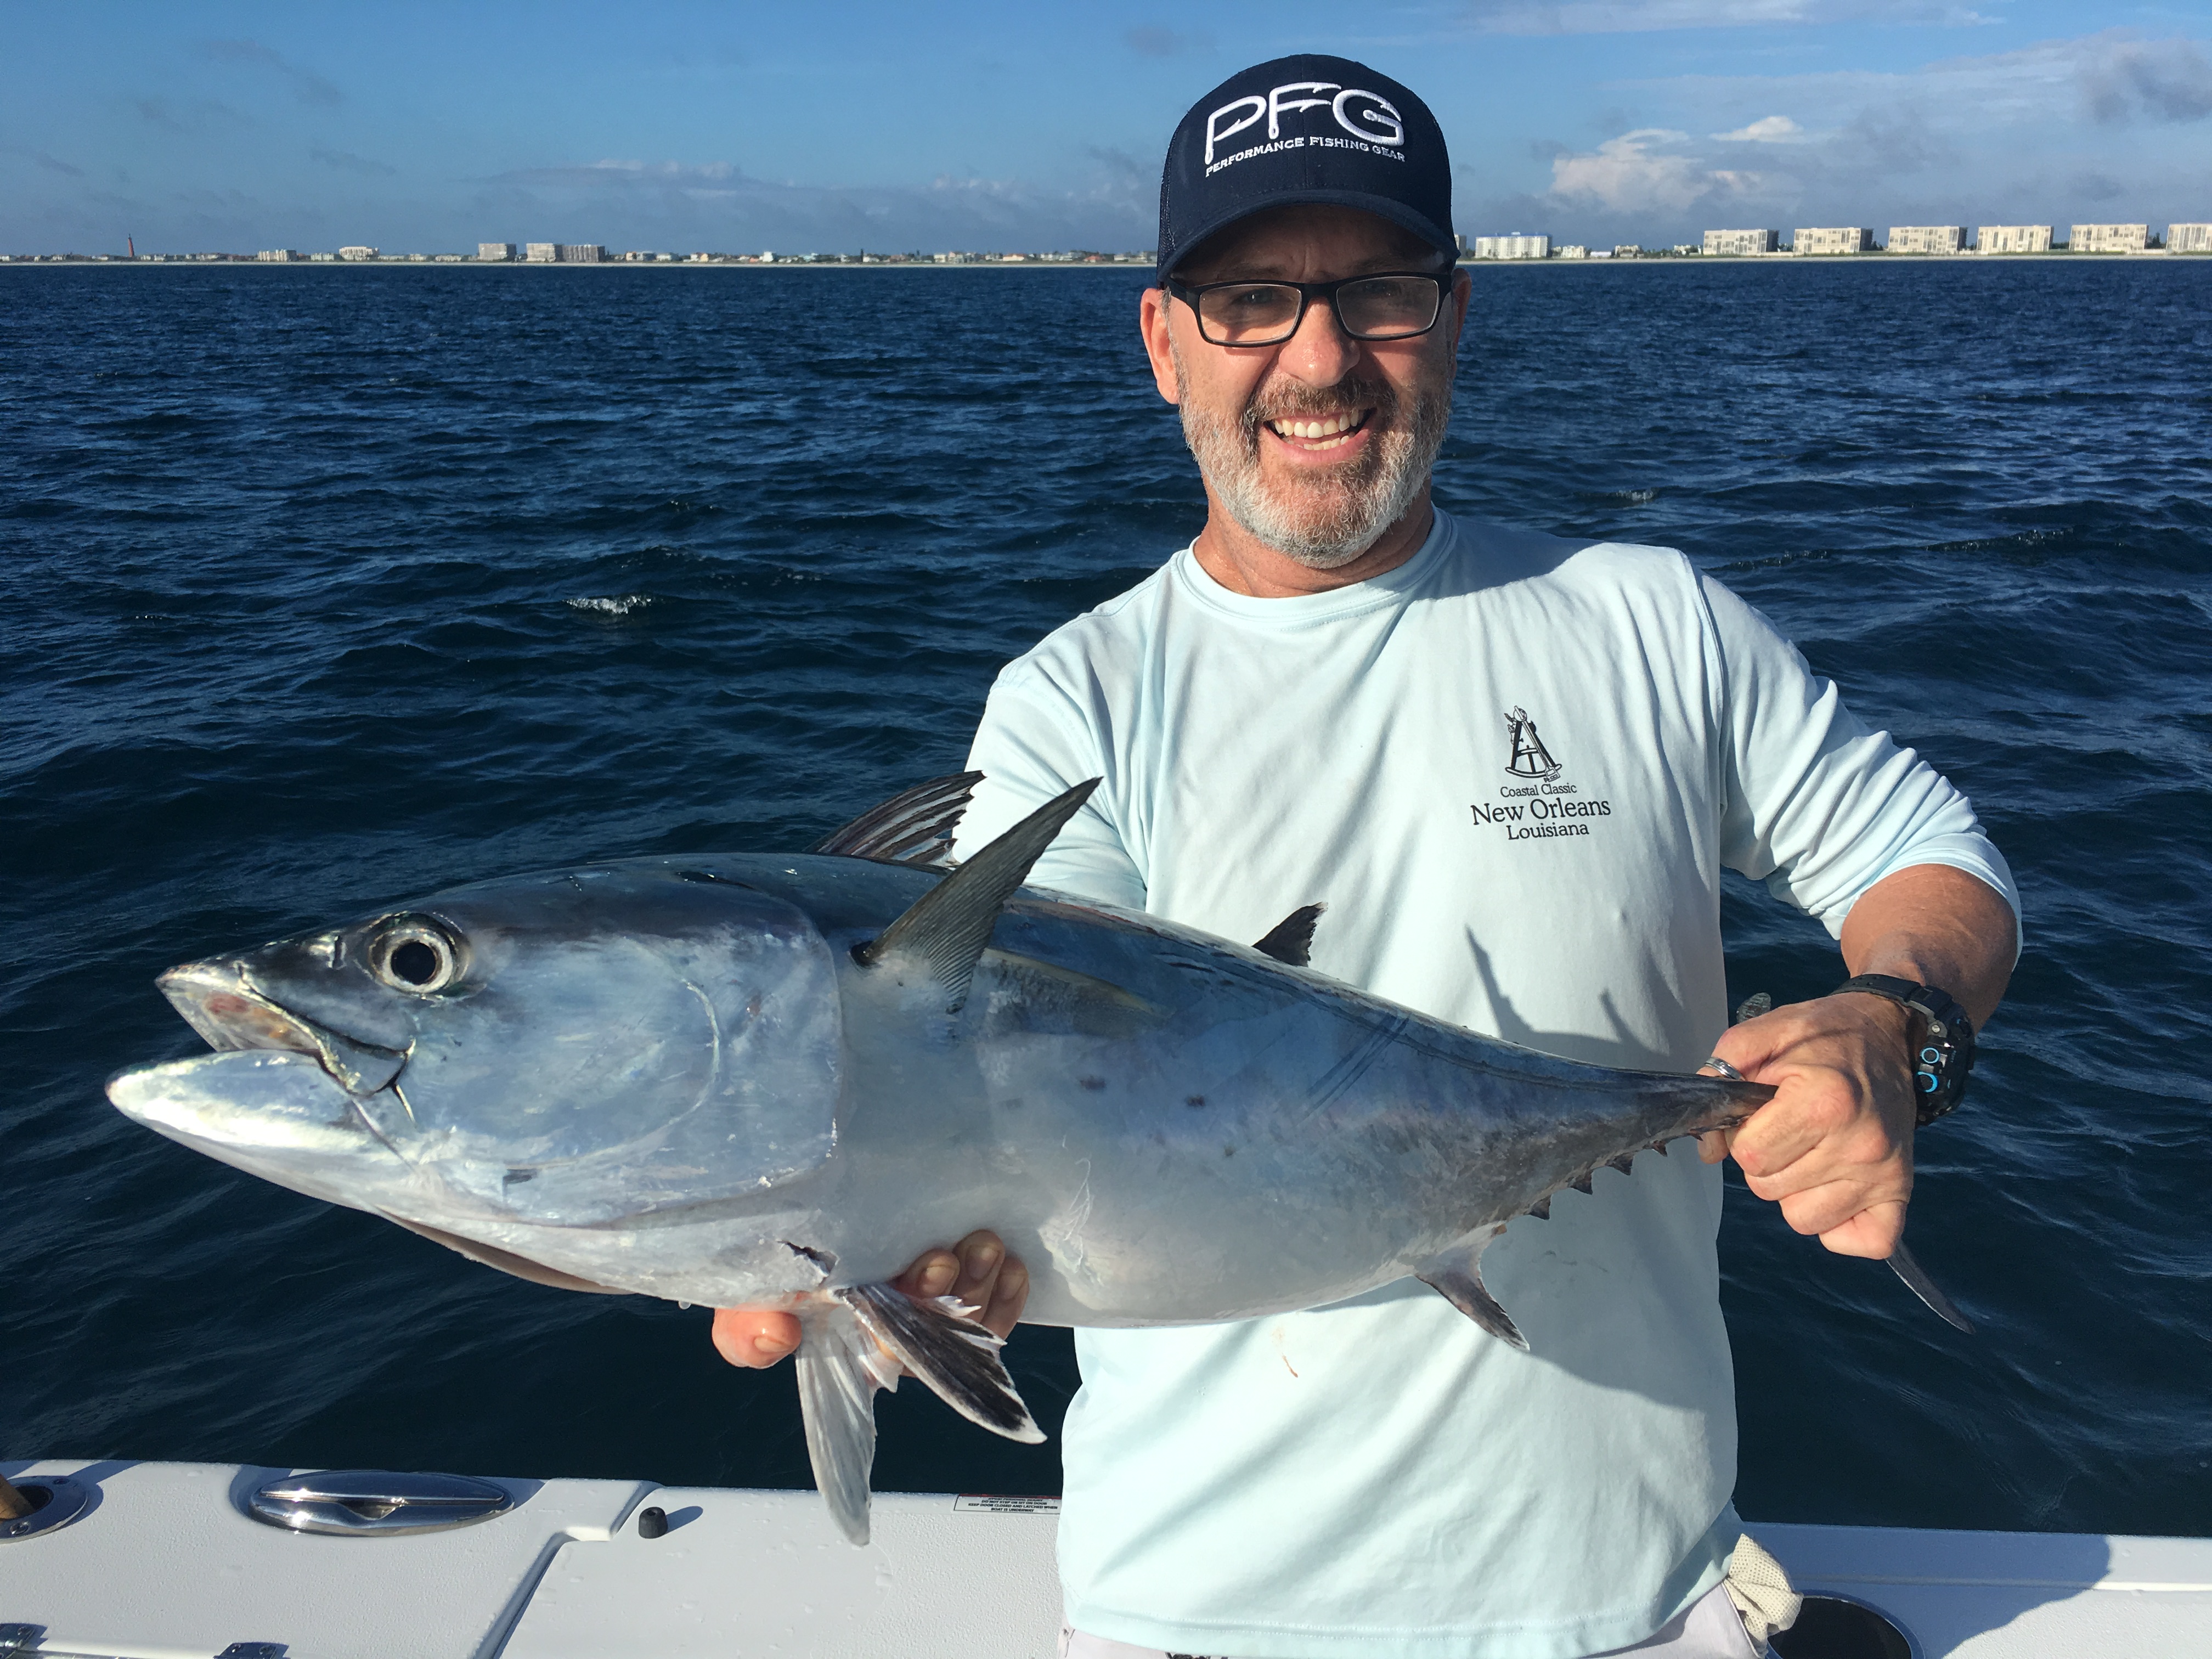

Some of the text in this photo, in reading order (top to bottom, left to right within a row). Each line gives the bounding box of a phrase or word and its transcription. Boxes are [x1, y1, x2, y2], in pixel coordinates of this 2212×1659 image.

[1204, 82, 1404, 165] PFG
[1205, 136, 1406, 177] PERFORMANCE FISHING GEAR
[1500, 782, 1578, 798] Coastal Classic
[1470, 797, 1611, 825] New Orleans
[1506, 822, 1590, 840] Louisiana
